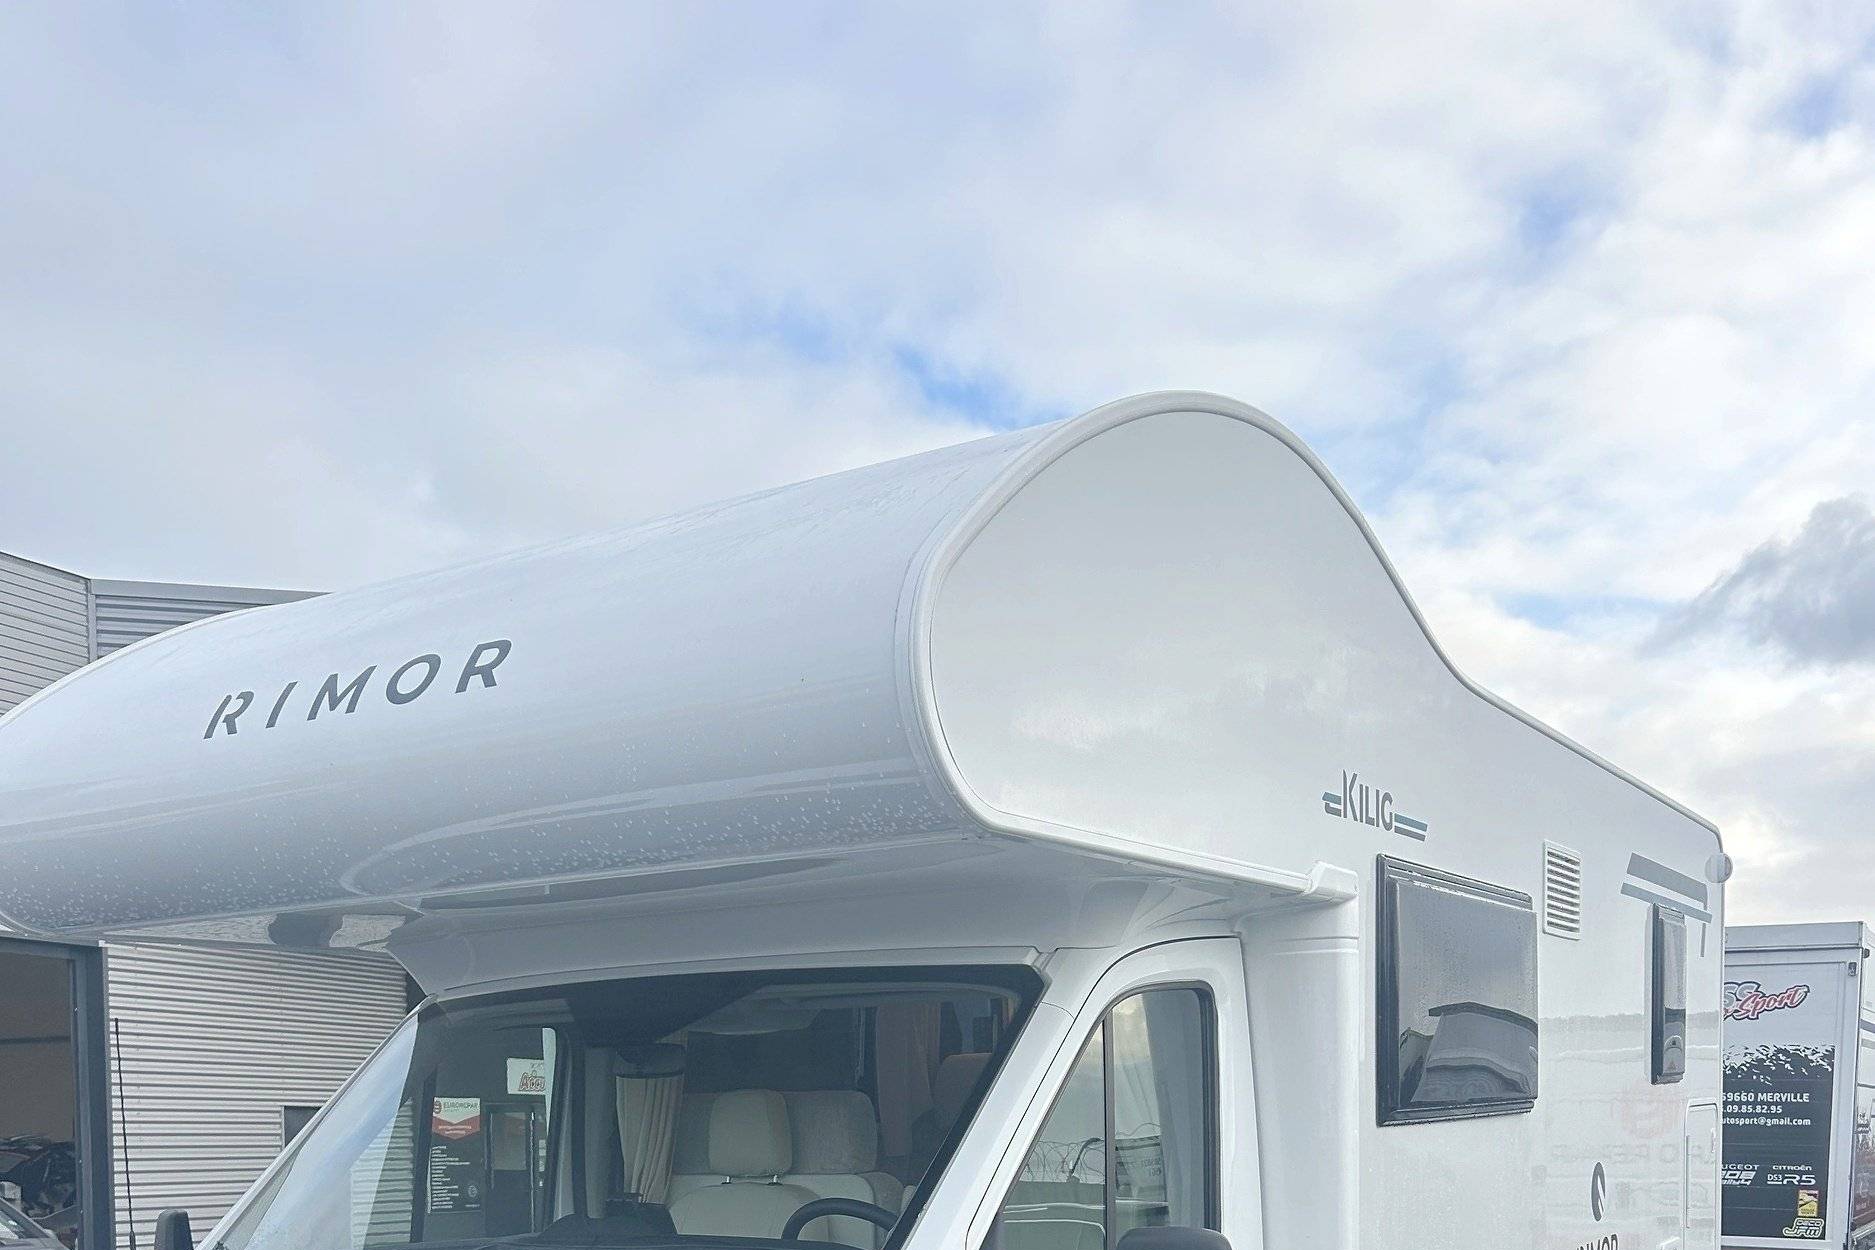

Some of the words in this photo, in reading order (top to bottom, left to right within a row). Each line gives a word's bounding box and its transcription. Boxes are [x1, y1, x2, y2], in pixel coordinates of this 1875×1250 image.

[203, 639, 512, 739] RIMOR
[1342, 769, 1393, 831] KILIG
[1734, 985, 1810, 1020] Sport
[1757, 1092, 1810, 1102] MERVILLE
[1767, 1173, 1783, 1181] DS3
[1782, 1173, 1817, 1186] R5
